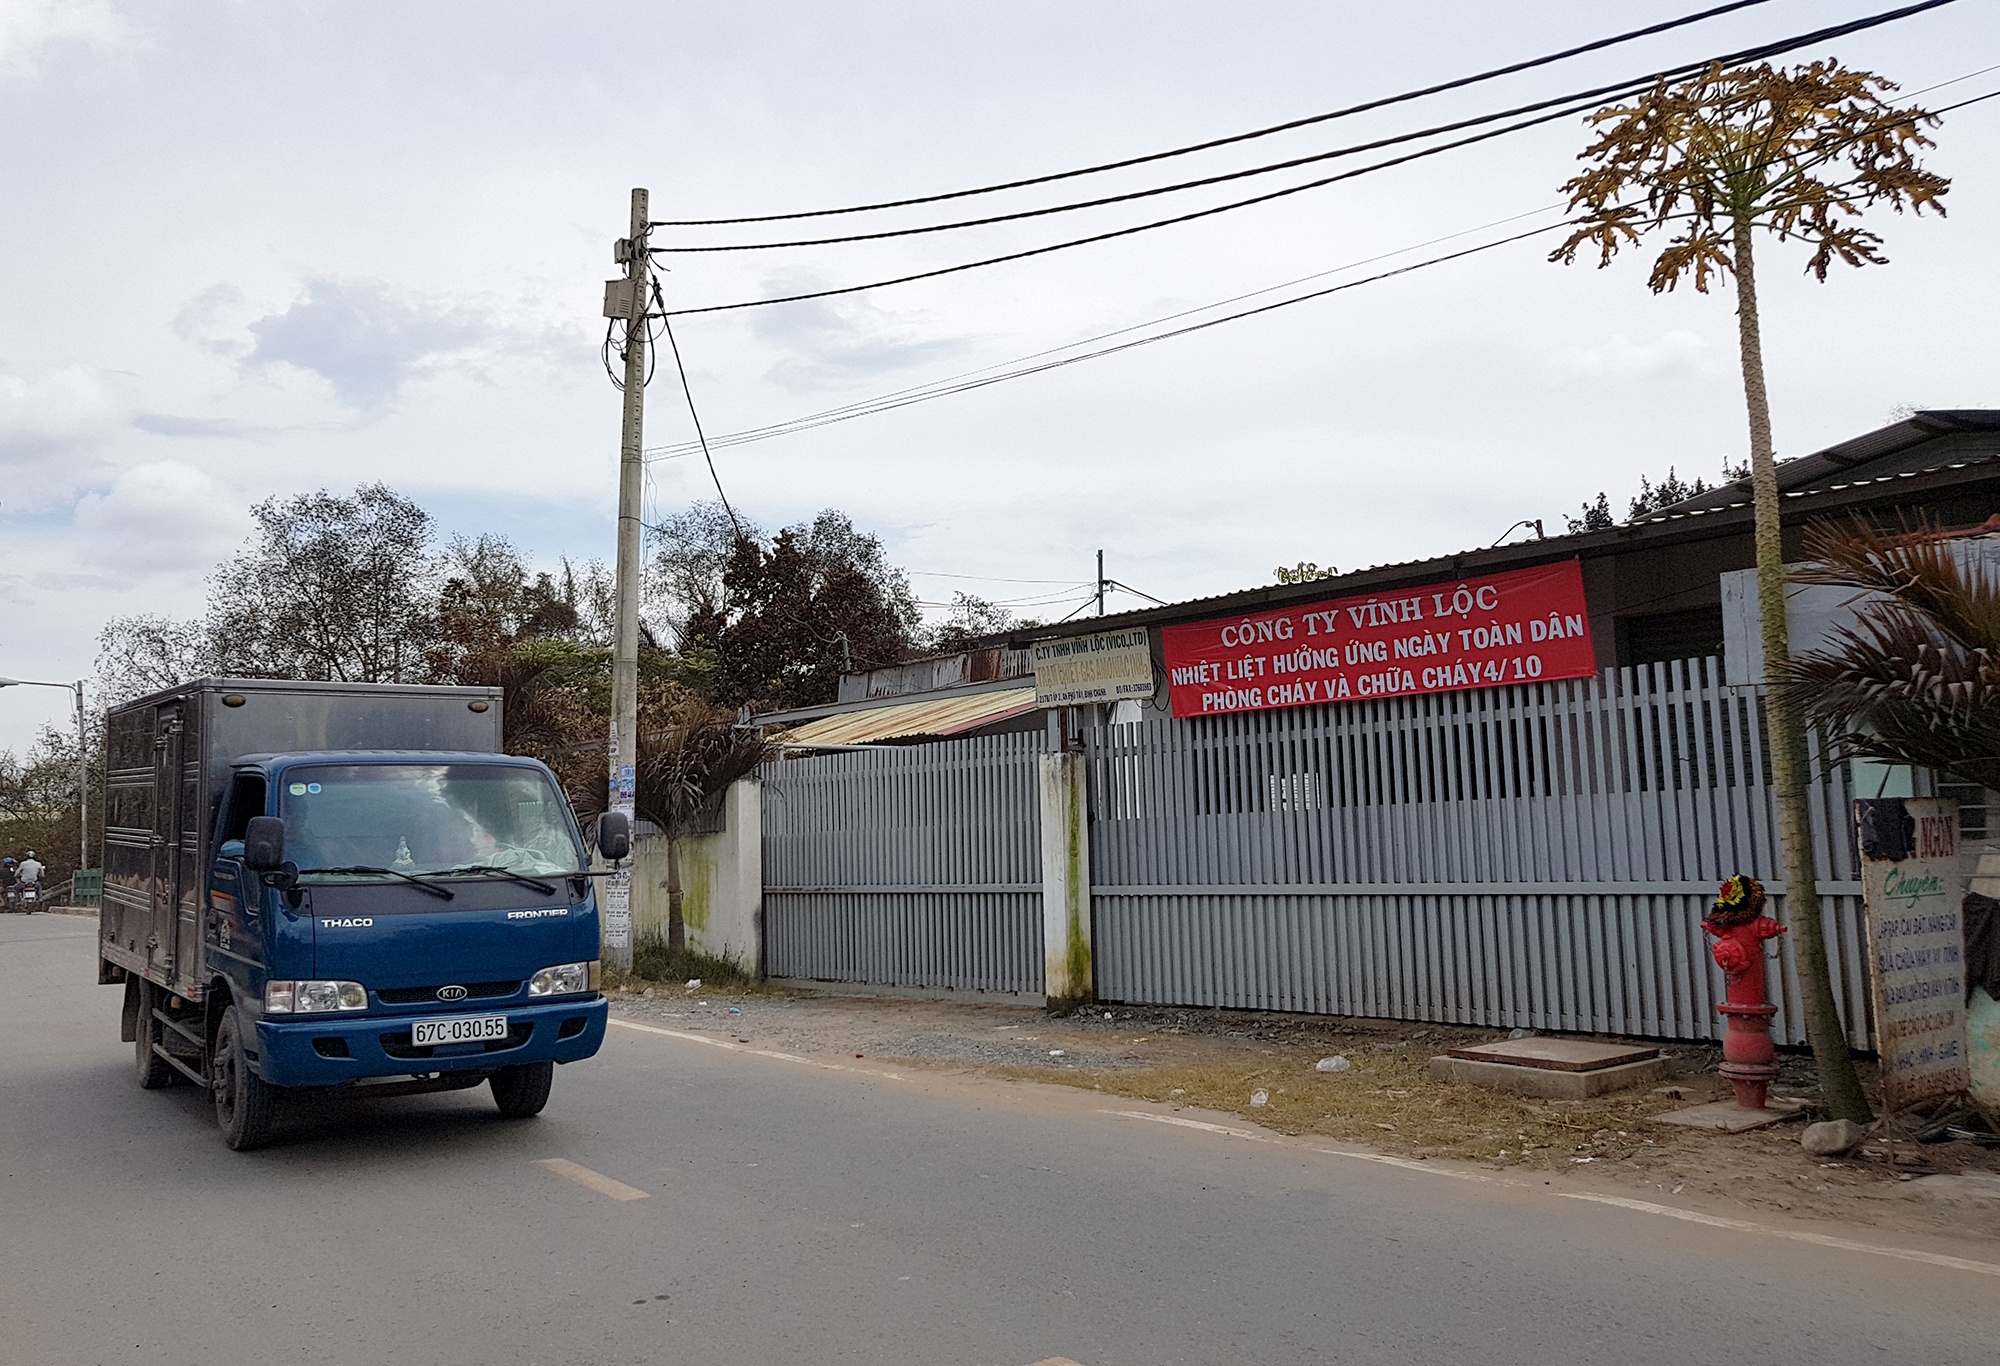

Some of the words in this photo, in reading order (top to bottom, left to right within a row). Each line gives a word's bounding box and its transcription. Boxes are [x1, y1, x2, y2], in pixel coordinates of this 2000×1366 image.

[1221, 617, 1294, 648] CÔNG
[1302, 610, 1339, 636] TY
[1346, 598, 1424, 629] VĨNH
[1432, 583, 1498, 620] LỘC
[1035, 647, 1051, 661] C.TY
[1052, 643, 1071, 658] TNHH
[1071, 637, 1088, 655] VĨNH
[1090, 635, 1105, 654] LỘC
[1171, 659, 1221, 686] NHIỆT
[1227, 654, 1266, 682] LIỆT
[1273, 643, 1339, 674] HƯỞNG
[1345, 639, 1388, 666] ỨNG
[1394, 629, 1451, 659] NGÀY
[1458, 620, 1522, 651] TOÀN
[1530, 611, 1584, 643] DÂN
[1202, 686, 1262, 712] PHÒNG
[1267, 678, 1317, 705] CHÁY
[1323, 672, 1351, 699] VÀ
[1357, 666, 1416, 696] CHỮA
[321, 918, 373, 928] THACO
[508, 909, 568, 920] FRONTIER
[442, 988, 463, 998] KIA
[416, 1018, 504, 1042] 67C-030.55
